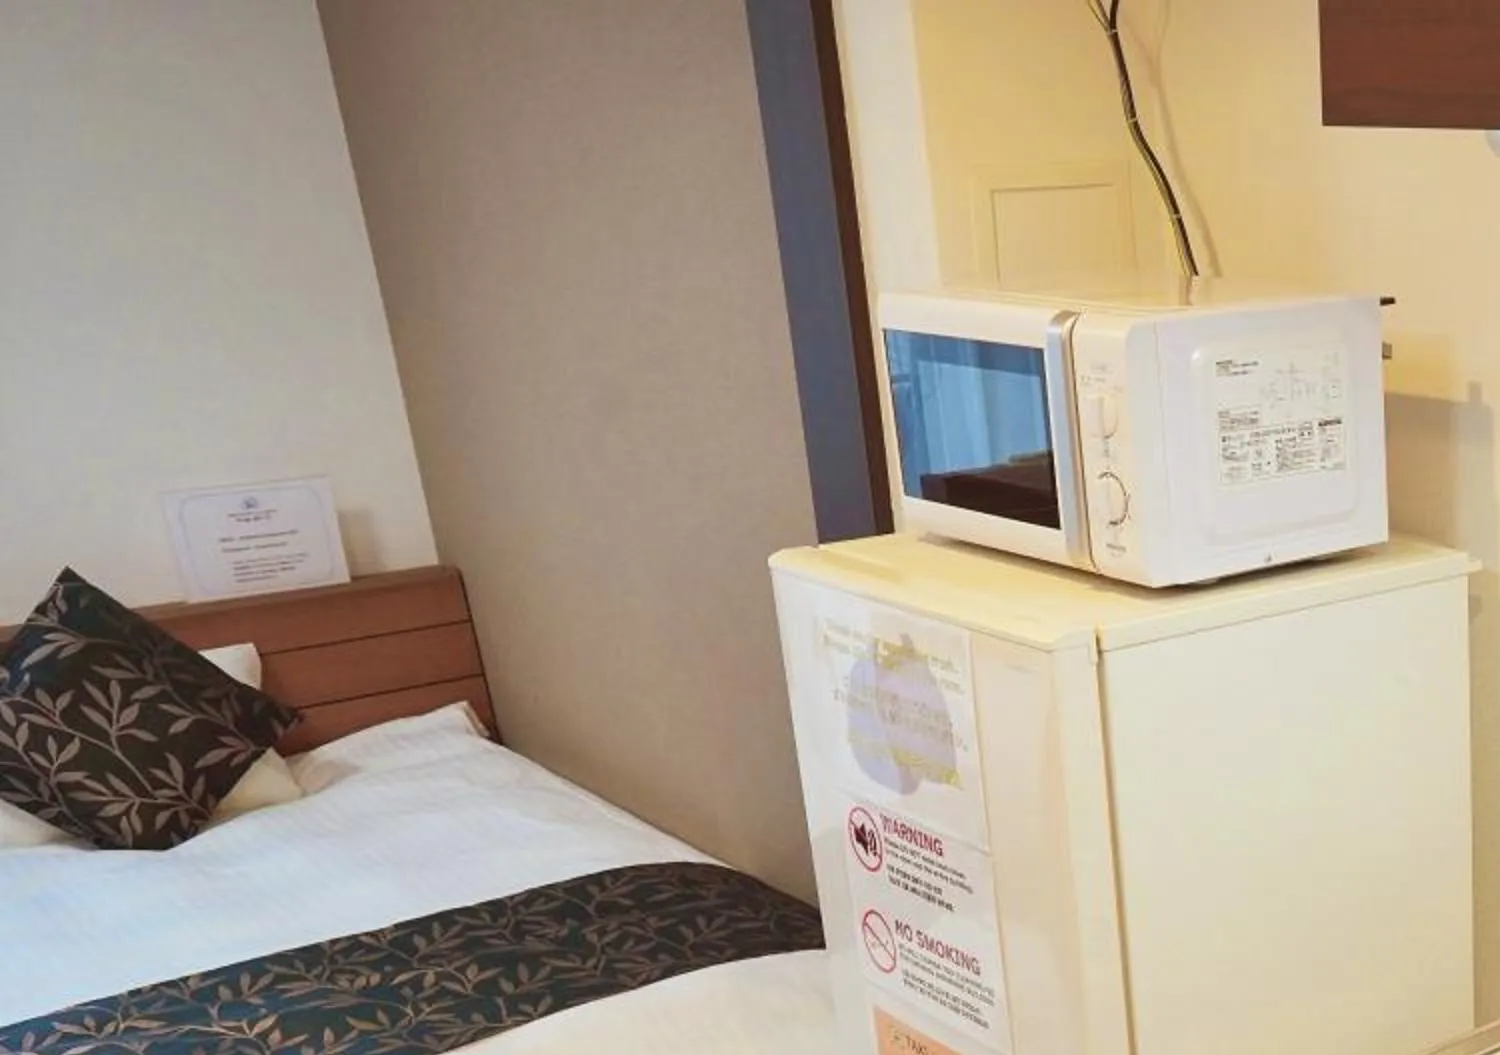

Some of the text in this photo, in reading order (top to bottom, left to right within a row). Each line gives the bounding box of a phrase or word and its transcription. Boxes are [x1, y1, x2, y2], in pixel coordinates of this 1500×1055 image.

[880, 811, 945, 857] WARNING
[895, 919, 913, 942] NO
[915, 929, 982, 977] SMOKING
